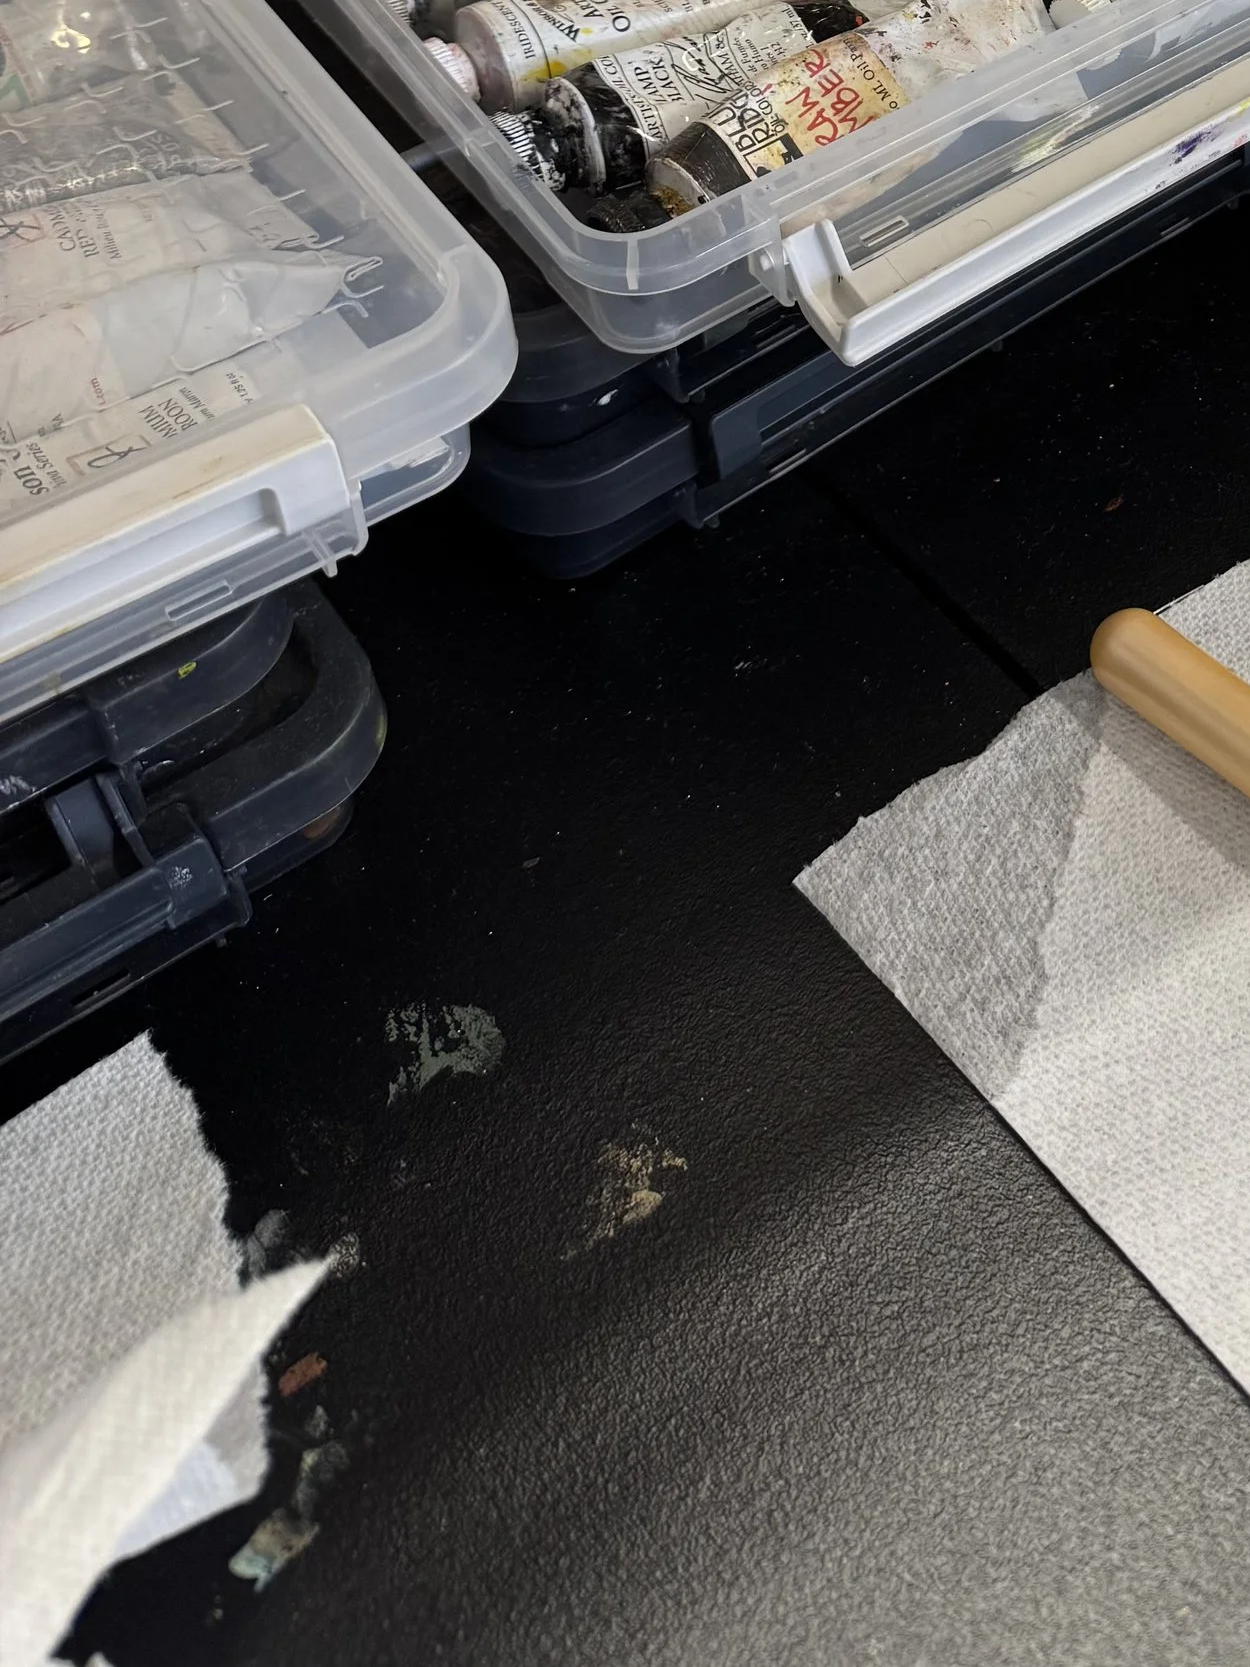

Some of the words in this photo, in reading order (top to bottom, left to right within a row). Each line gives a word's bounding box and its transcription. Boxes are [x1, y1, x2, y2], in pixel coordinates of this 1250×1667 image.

[606, 5, 632, 34] OIL
[744, 38, 762, 65] Humo
[842, 38, 863, 63] Pain
[633, 65, 669, 105] LAMP
[858, 61, 876, 82] Oil
[803, 48, 876, 135] MBER
[872, 85, 892, 102] ML
[785, 86, 839, 147] RAW
[158, 397, 199, 432] ROON
[25, 441, 53, 471] Series
